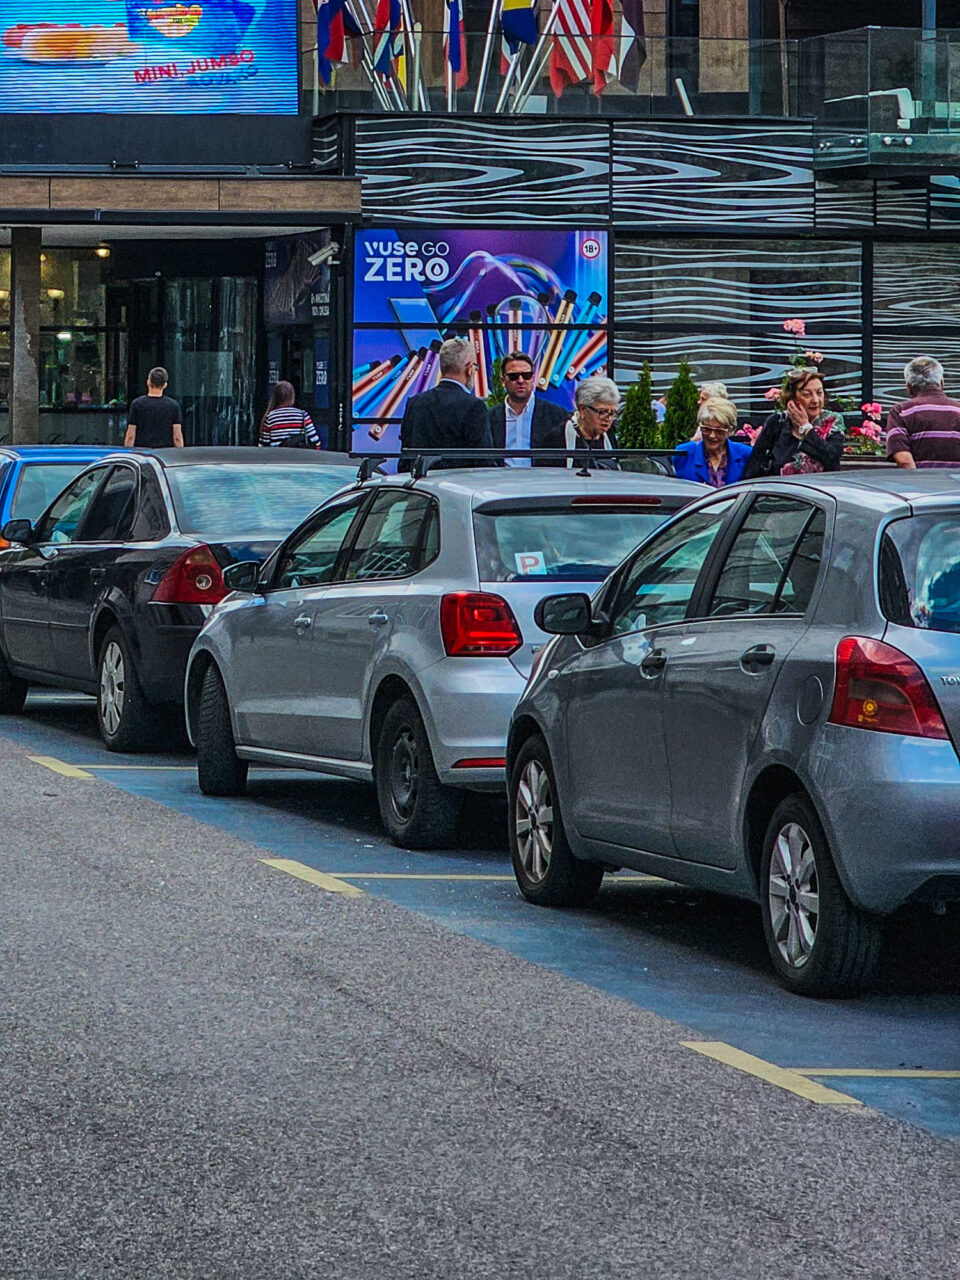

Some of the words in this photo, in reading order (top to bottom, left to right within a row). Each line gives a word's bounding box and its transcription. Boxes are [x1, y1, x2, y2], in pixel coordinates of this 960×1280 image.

[133, 63, 179, 83] MINI
[187, 49, 255, 74] JUMBO
[421, 241, 450, 256] GO
[584, 244, 598, 253] 18+
[364, 257, 450, 282] ZERO
